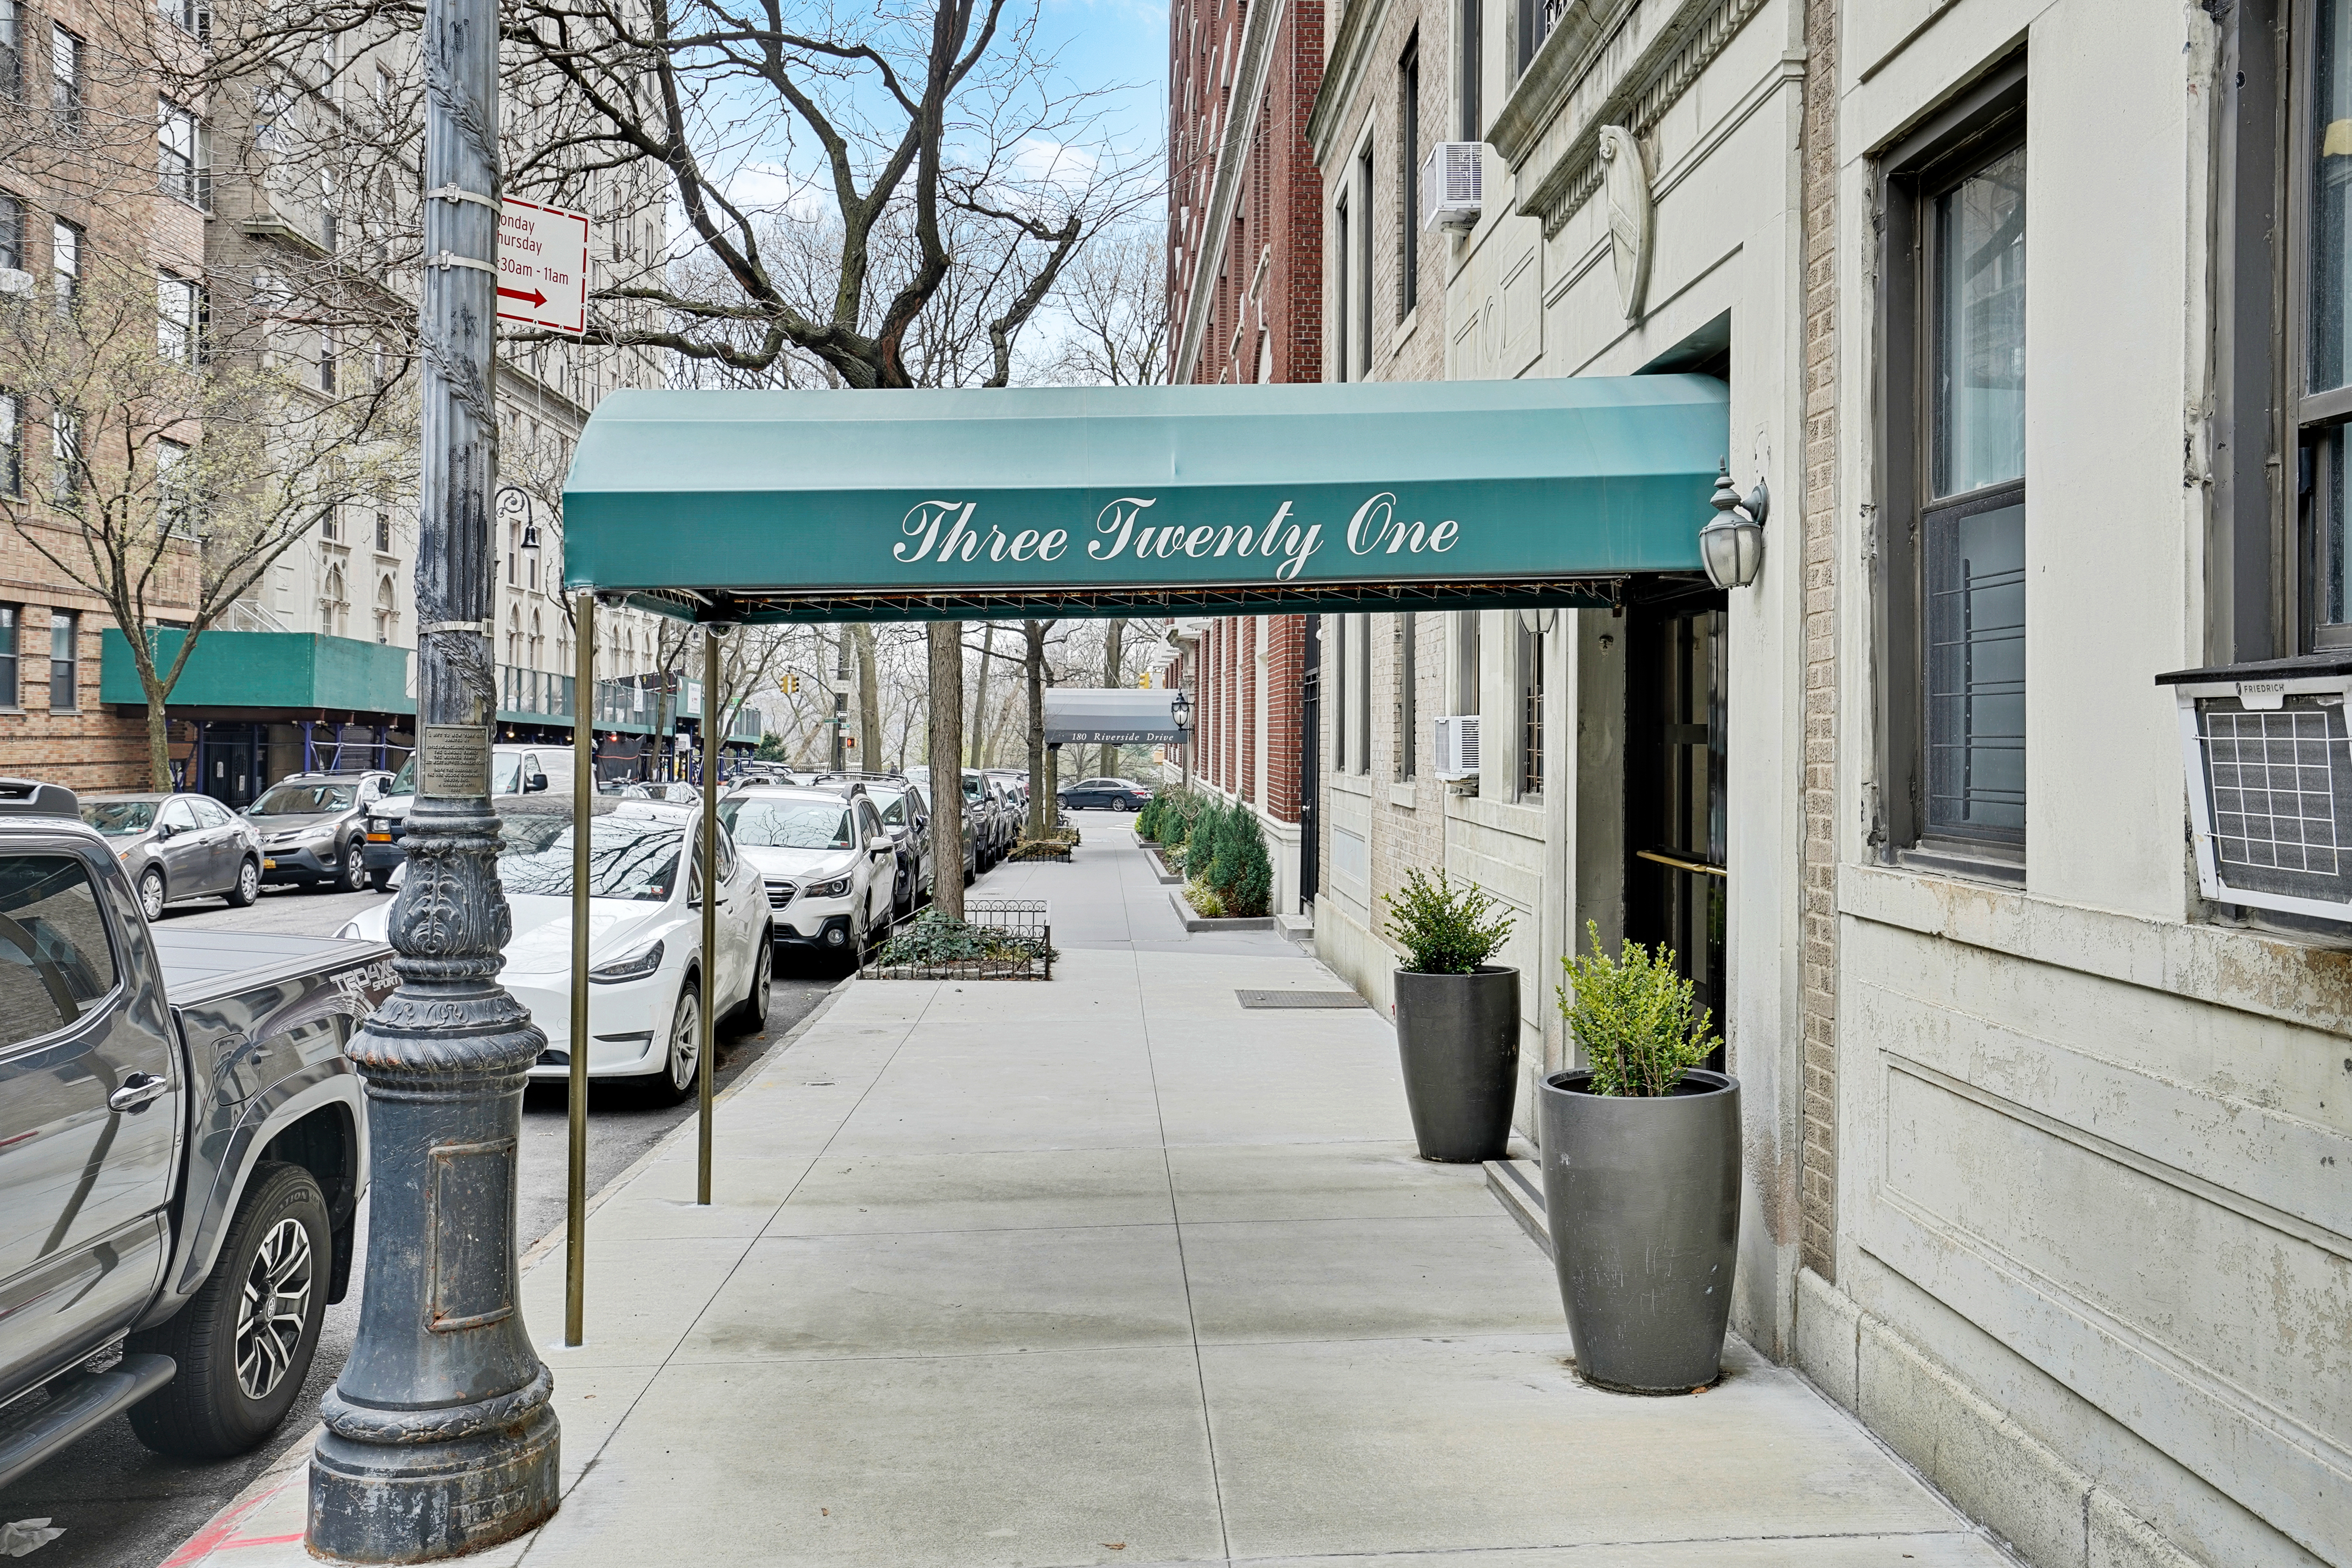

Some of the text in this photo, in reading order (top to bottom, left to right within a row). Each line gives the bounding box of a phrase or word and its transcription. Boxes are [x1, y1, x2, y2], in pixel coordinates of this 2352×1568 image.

[500, 215, 534, 235] onday
[497, 230, 542, 256] hursday
[497, 257, 532, 277] :30am
[544, 267, 568, 285] 11am
[893, 492, 1459, 581] Three Twenty One
[2244, 684, 2284, 693] FRIEDRICH
[1093, 733, 1140, 741] Riverside
[1147, 733, 1174, 741] Drive
[329, 967, 371, 995] TRD
[372, 975, 398, 992] SPORT
